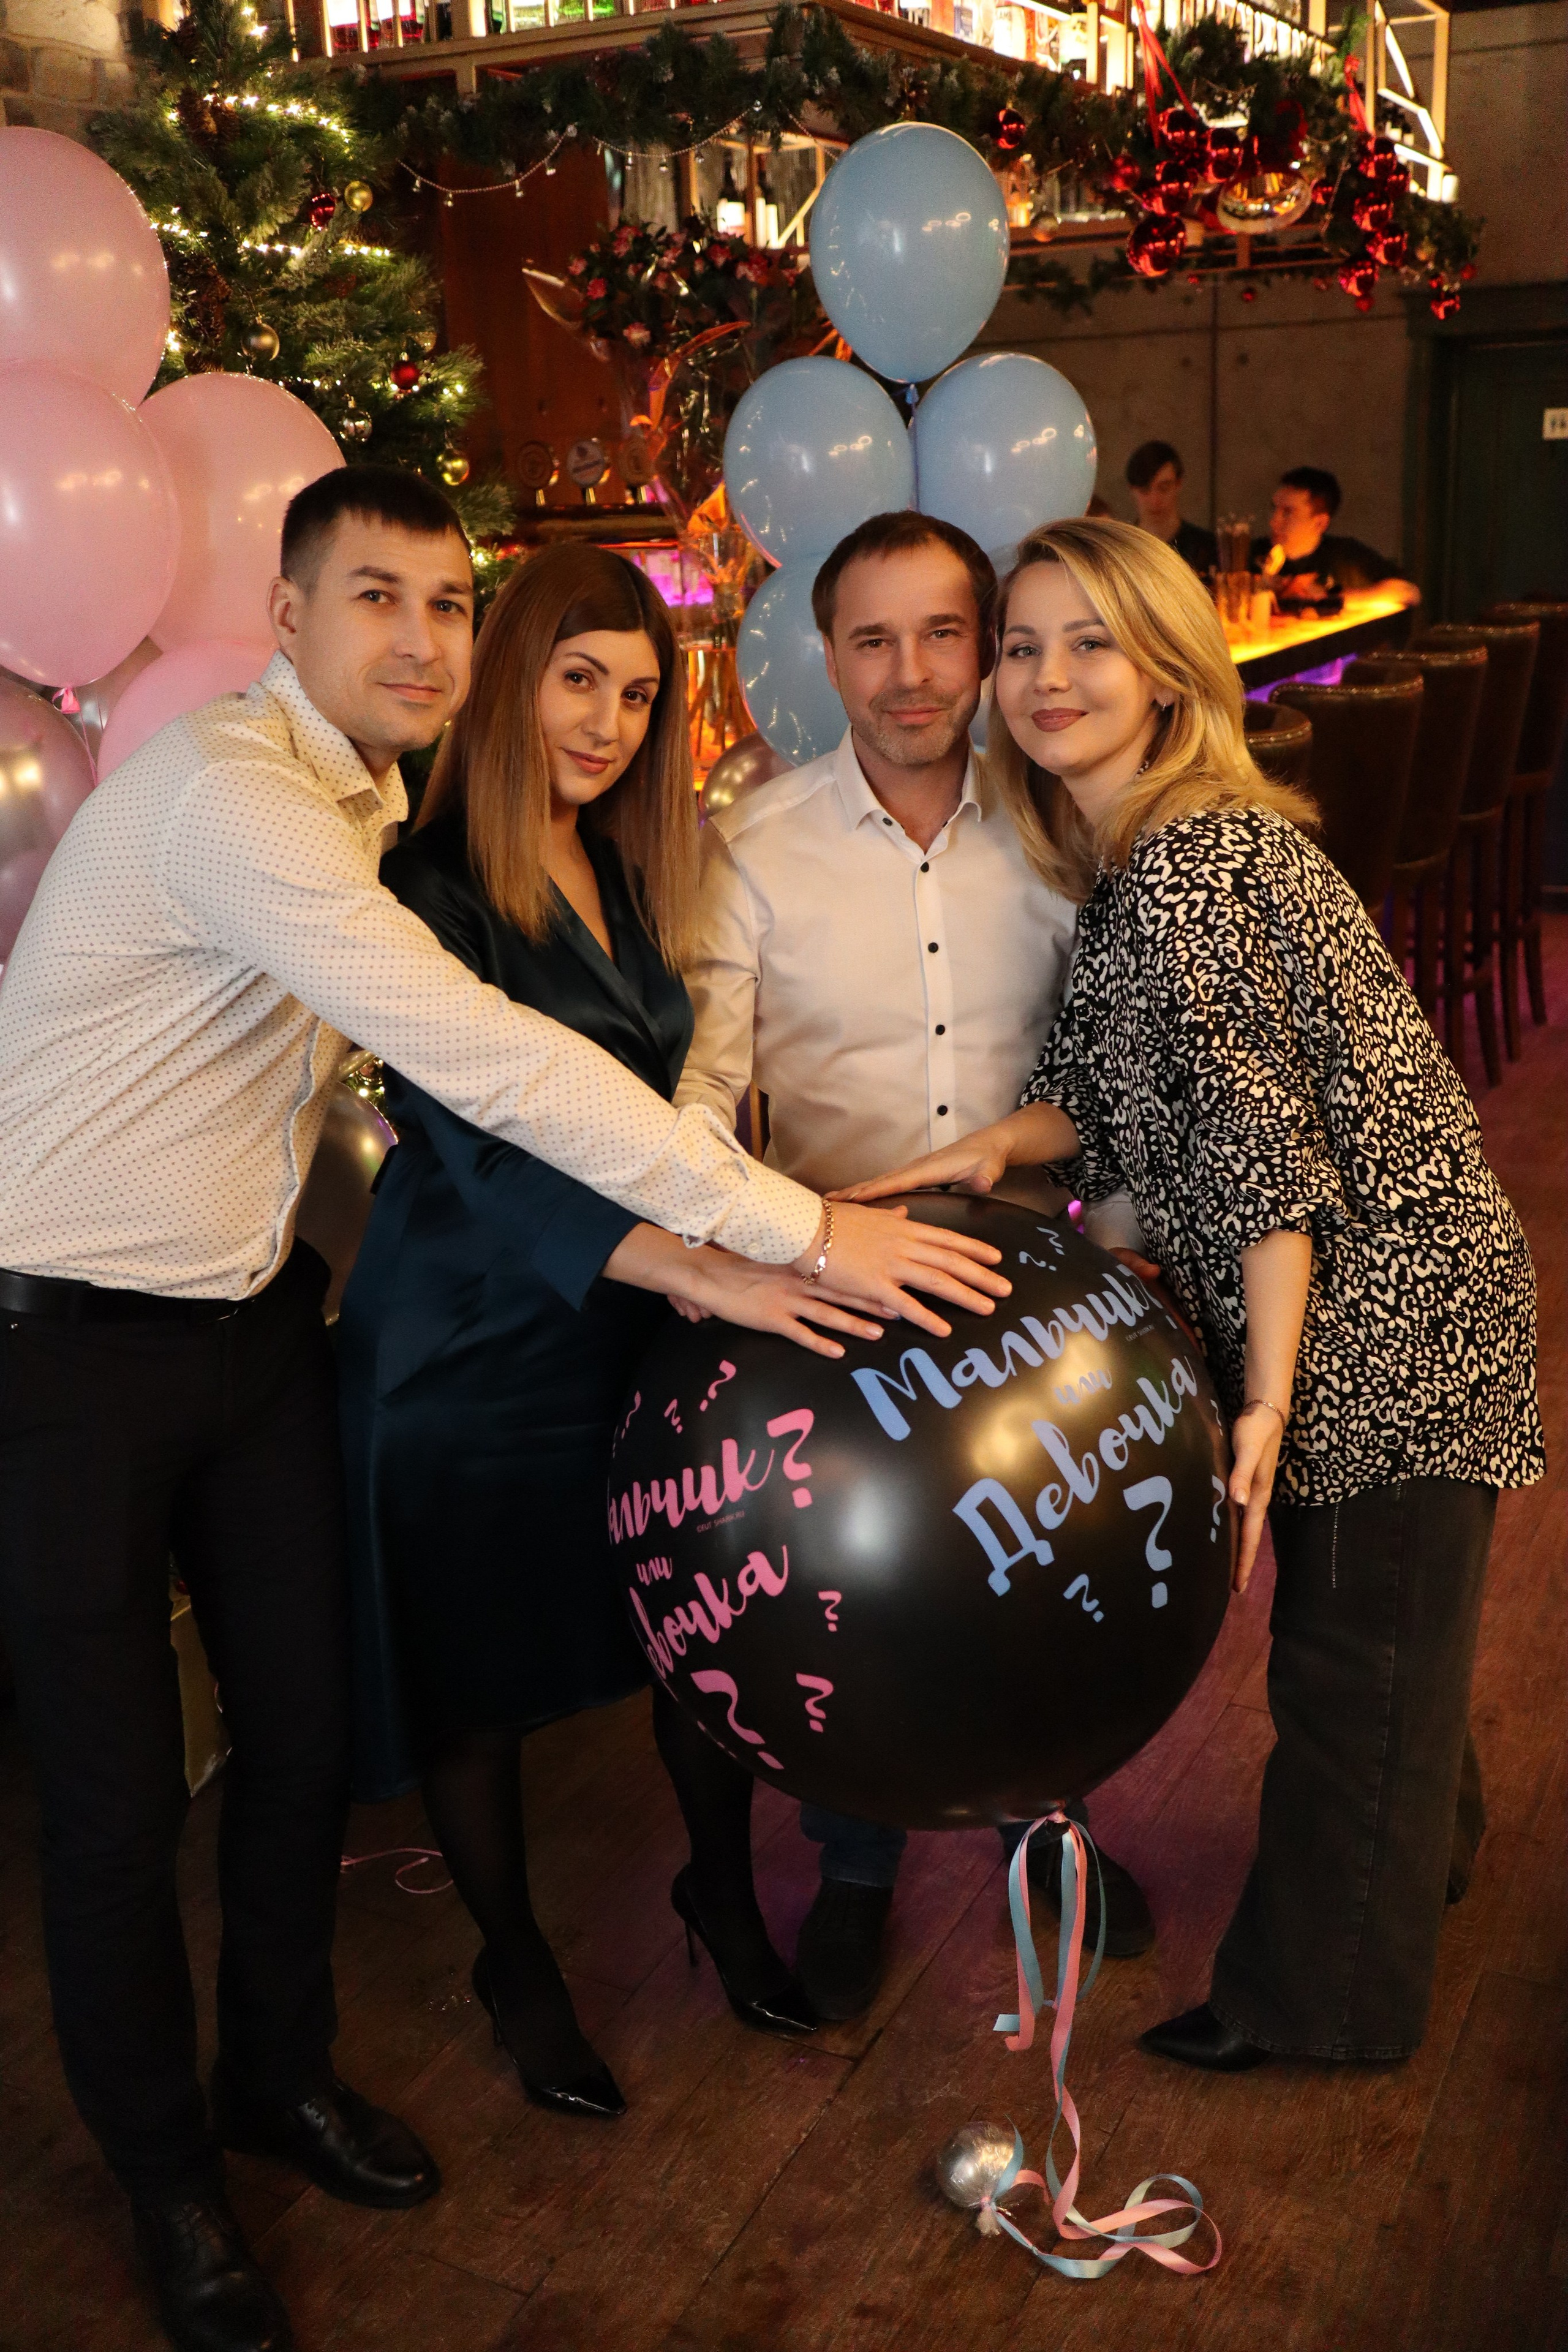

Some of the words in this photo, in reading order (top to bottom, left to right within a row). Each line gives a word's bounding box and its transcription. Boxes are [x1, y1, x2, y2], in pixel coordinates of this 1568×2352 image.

[850, 1273, 1150, 1441] Мальчик
[1054, 1366, 1113, 1406] или
[608, 1438, 775, 1544] альчик
[766, 1408, 814, 1509] ?
[952, 1355, 1197, 1597] Девочка
[1123, 1476, 1172, 1608] ?
[629, 1544, 789, 1702] евочка
[636, 1557, 673, 1586] или
